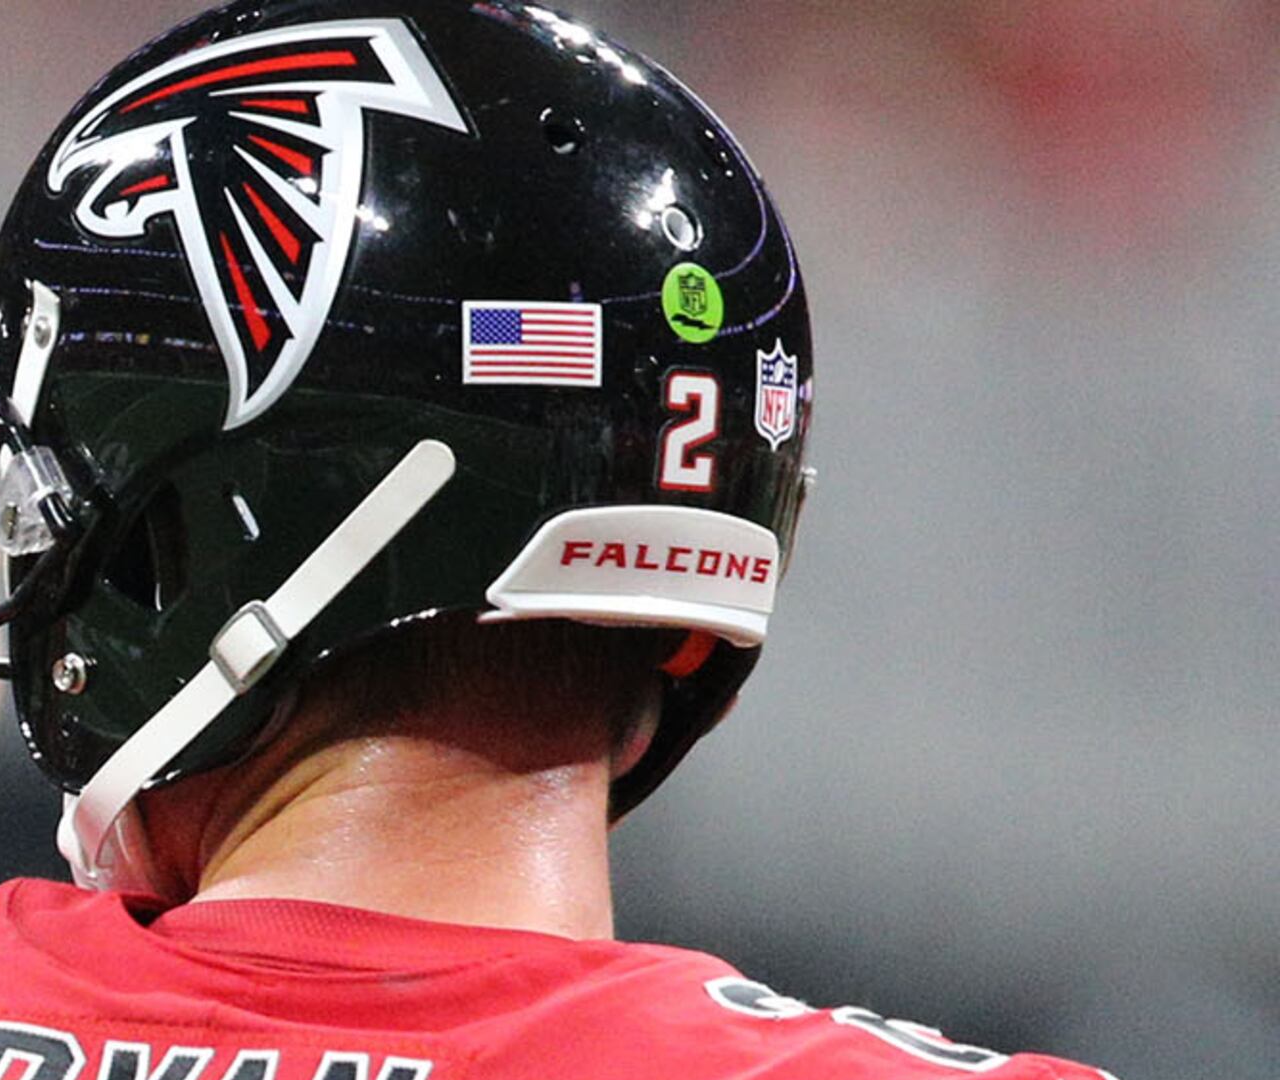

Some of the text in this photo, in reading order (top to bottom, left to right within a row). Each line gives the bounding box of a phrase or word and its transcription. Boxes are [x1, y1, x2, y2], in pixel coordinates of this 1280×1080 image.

[657, 368, 720, 492] 2
[762, 387, 791, 430] NFL
[560, 541, 771, 584] FALCONS
